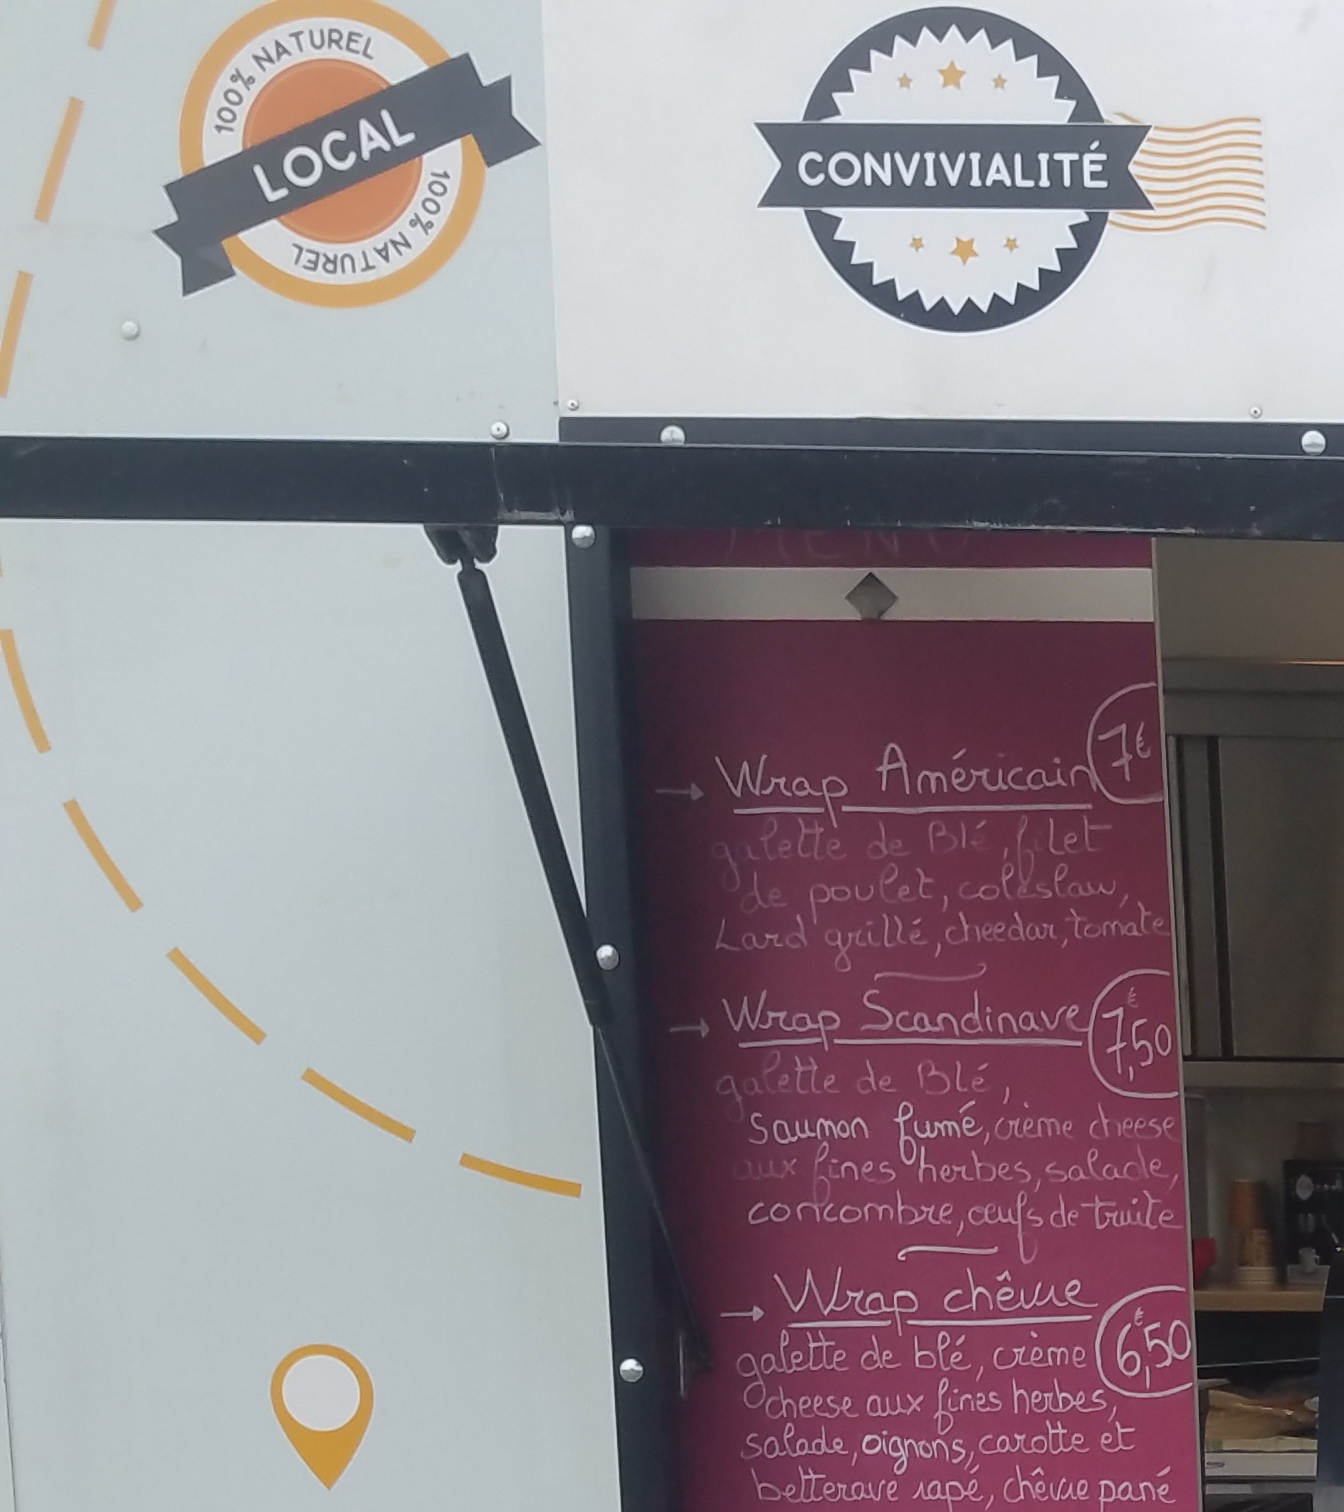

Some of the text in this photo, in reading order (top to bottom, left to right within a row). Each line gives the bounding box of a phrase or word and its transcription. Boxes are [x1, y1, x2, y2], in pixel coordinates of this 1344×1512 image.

[214, 28, 374, 134] 100% NATUREL
[252, 109, 416, 202] LOCAL
[797, 141, 1108, 190] CONVIVIALITÉ
[292, 168, 450, 274] 100% NATUREL
[715, 754, 848, 828] Wrap
[876, 743, 1099, 795] Américain
[711, 818, 846, 892] galette
[867, 822, 909, 857] de
[740, 872, 784, 914] de
[715, 915, 808, 952] Lard
[1070, 901, 1170, 940] tomate
[721, 989, 841, 1051] Wrap
[860, 989, 1093, 1035] Scandinave
[716, 1053, 840, 1121] galette
[857, 1060, 897, 1093] de
[748, 1113, 869, 1145] Saumon
[1089, 1108, 1176, 1139] cheese
[734, 1156, 797, 1181] aux
[813, 1142, 896, 1204] fines
[1050, 1199, 1079, 1228] de
[774, 1267, 917, 1336] Wrap
[736, 1330, 849, 1408] galette
[860, 1336, 901, 1371] de
[765, 1390, 859, 1418] cheese
[866, 1395, 922, 1414] aux
[937, 1378, 1002, 1435] fines
[978, 1423, 1090, 1454] carotte
[1100, 1422, 1135, 1452] et
[751, 1468, 898, 1501] betterave
